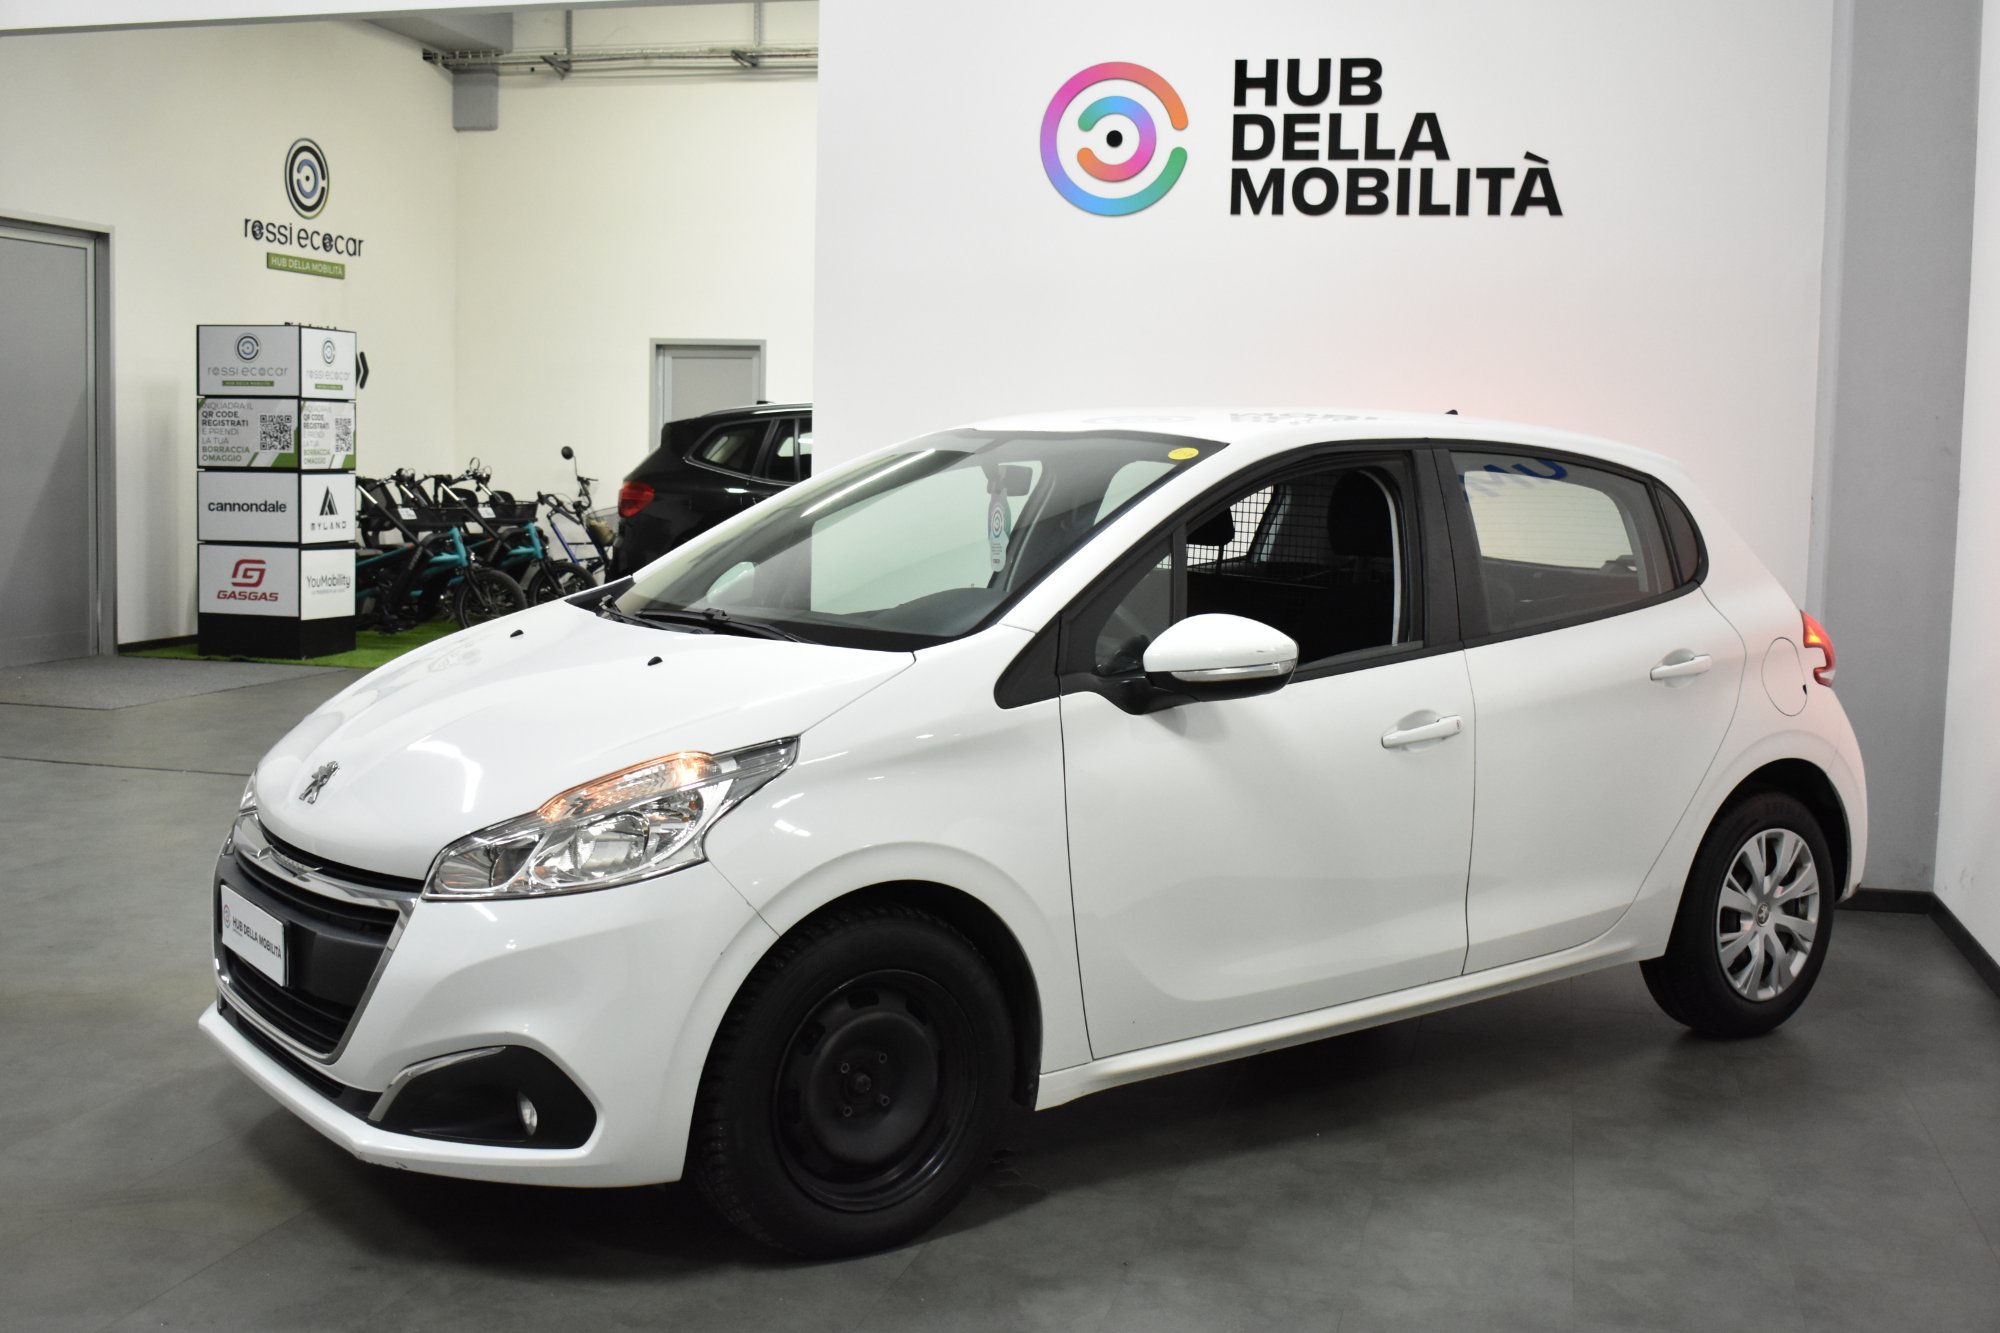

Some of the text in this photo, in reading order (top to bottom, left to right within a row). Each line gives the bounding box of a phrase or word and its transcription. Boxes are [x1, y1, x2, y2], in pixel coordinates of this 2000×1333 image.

[1233, 57, 1383, 107] HUB
[1231, 112, 1450, 161] DELLA
[1229, 150, 1563, 216] MOBILITÀ
[271, 257, 287, 267] HUB
[288, 258, 311, 270] DELLA
[202, 419, 249, 427] REGISTRATI
[202, 454, 242, 462] OMAGGIO
[207, 500, 287, 513] cannondale
[216, 590, 279, 602] GASGAS
[232, 916, 242, 932] HUB
[243, 924, 258, 944] DELLA
